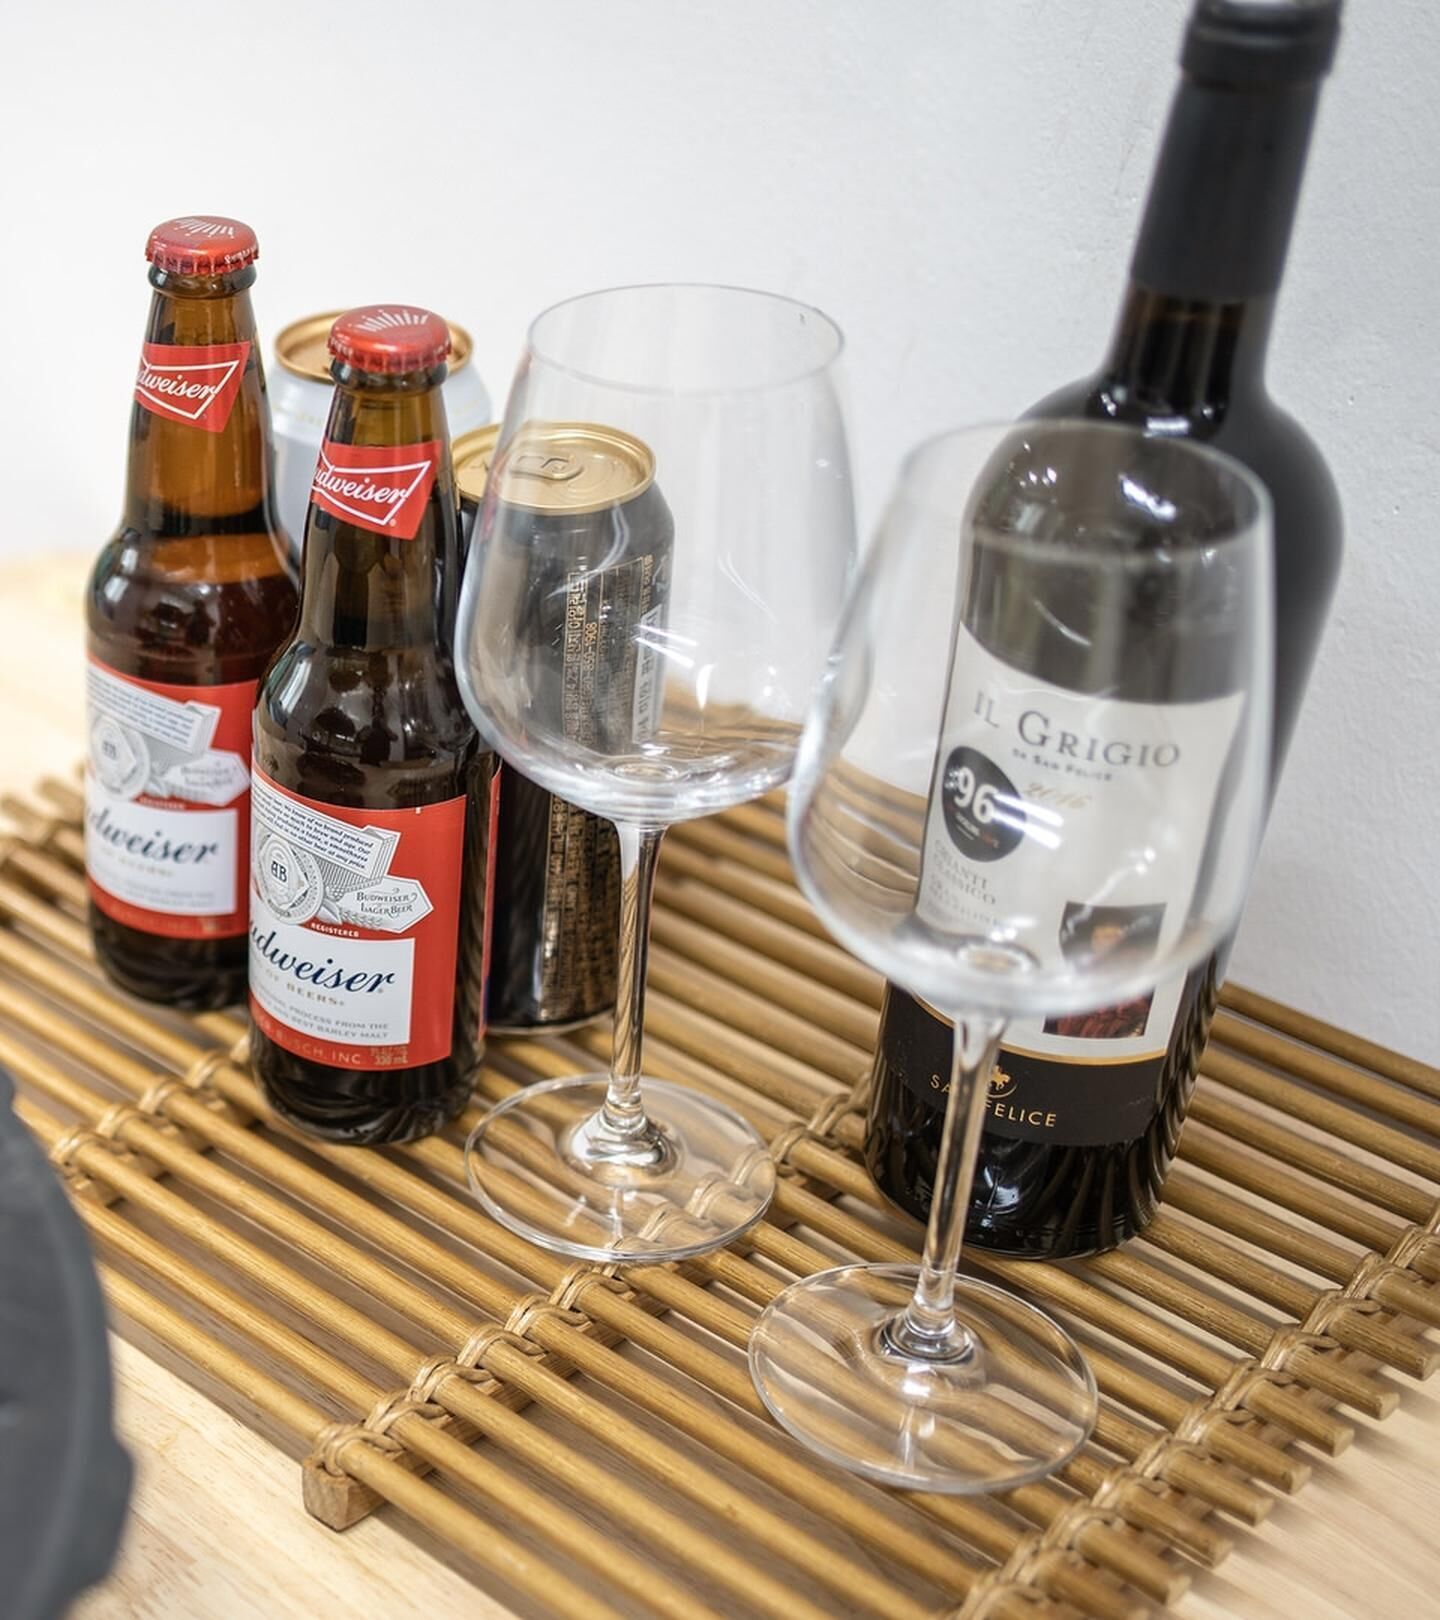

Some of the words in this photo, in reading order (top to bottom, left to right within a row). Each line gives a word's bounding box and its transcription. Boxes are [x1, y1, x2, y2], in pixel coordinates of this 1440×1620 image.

[973, 690, 1001, 729] IL
[1017, 710, 1181, 769] GRIGIO
[952, 766, 1001, 824] 96
[356, 890, 412, 903] BUDWEISER
[310, 922, 360, 938] REGISTERED
[929, 1073, 951, 1094] SA
